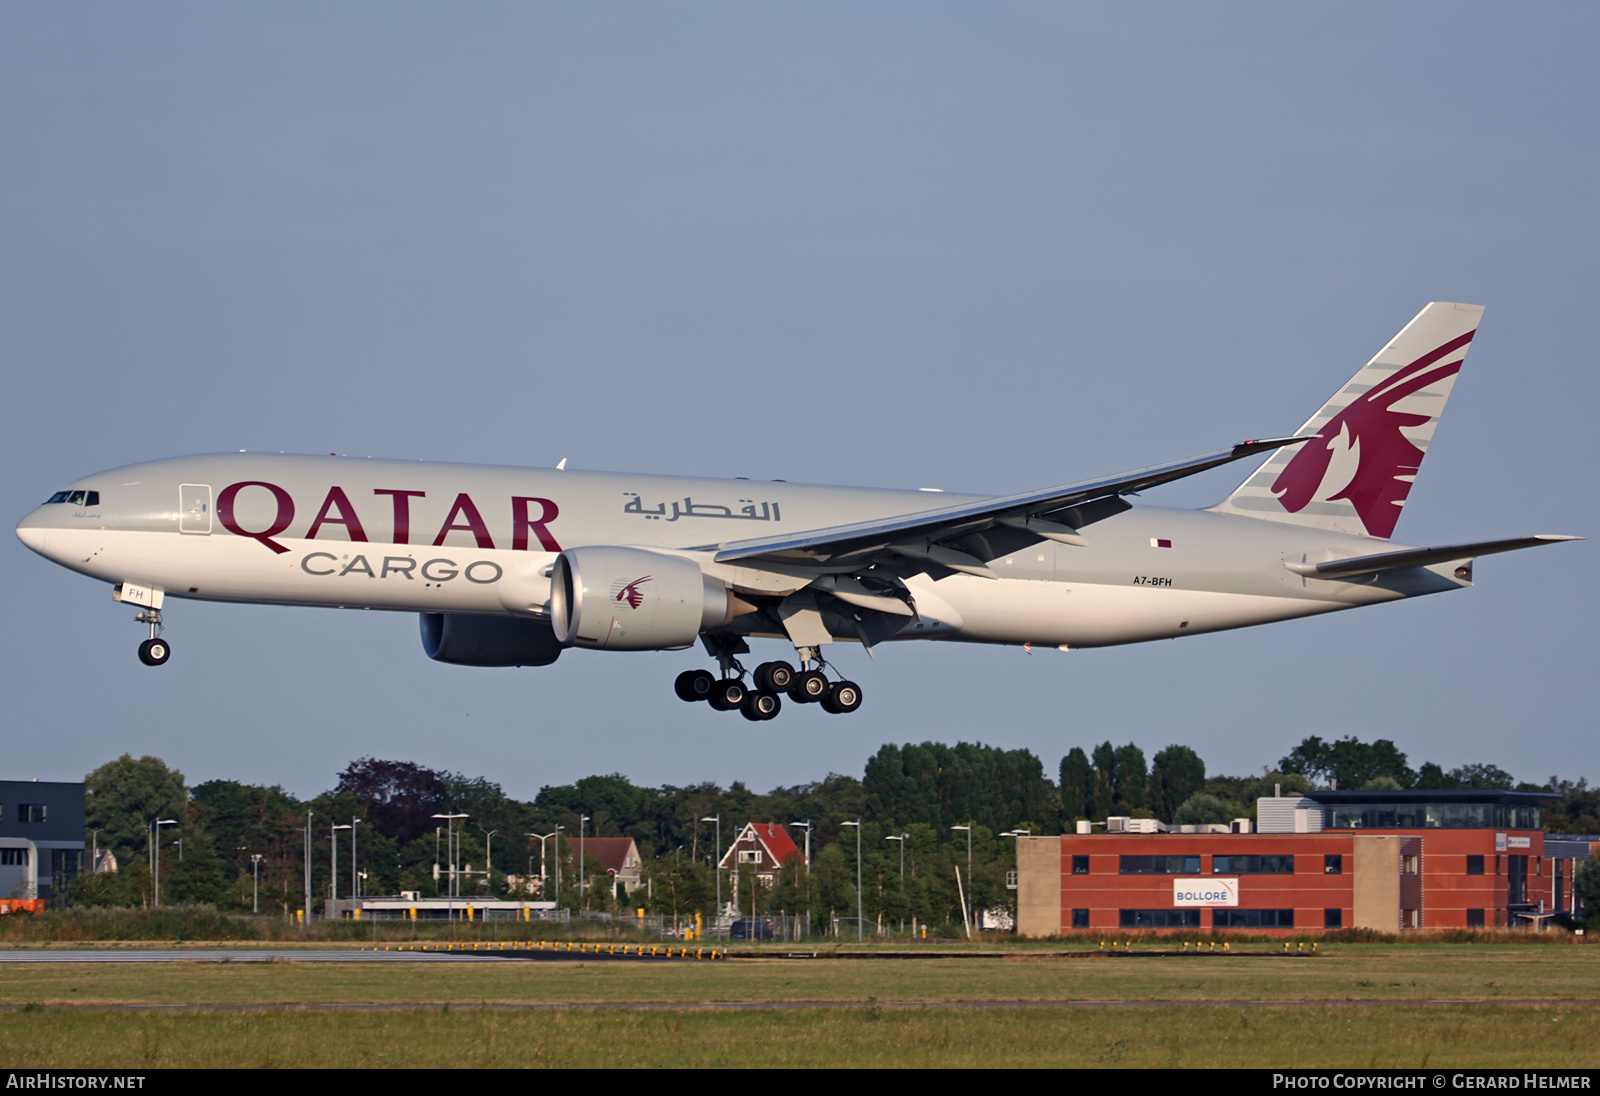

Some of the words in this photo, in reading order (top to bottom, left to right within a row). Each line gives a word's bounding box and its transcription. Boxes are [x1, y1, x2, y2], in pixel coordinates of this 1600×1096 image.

[216, 481, 563, 554] QATAR
[623, 493, 781, 522] القطرية
[301, 552, 503, 584] CARGO
[1133, 576, 1172, 587] A7-BFH
[129, 588, 143, 599] FH
[1177, 890, 1227, 901] BOLLORÉ
